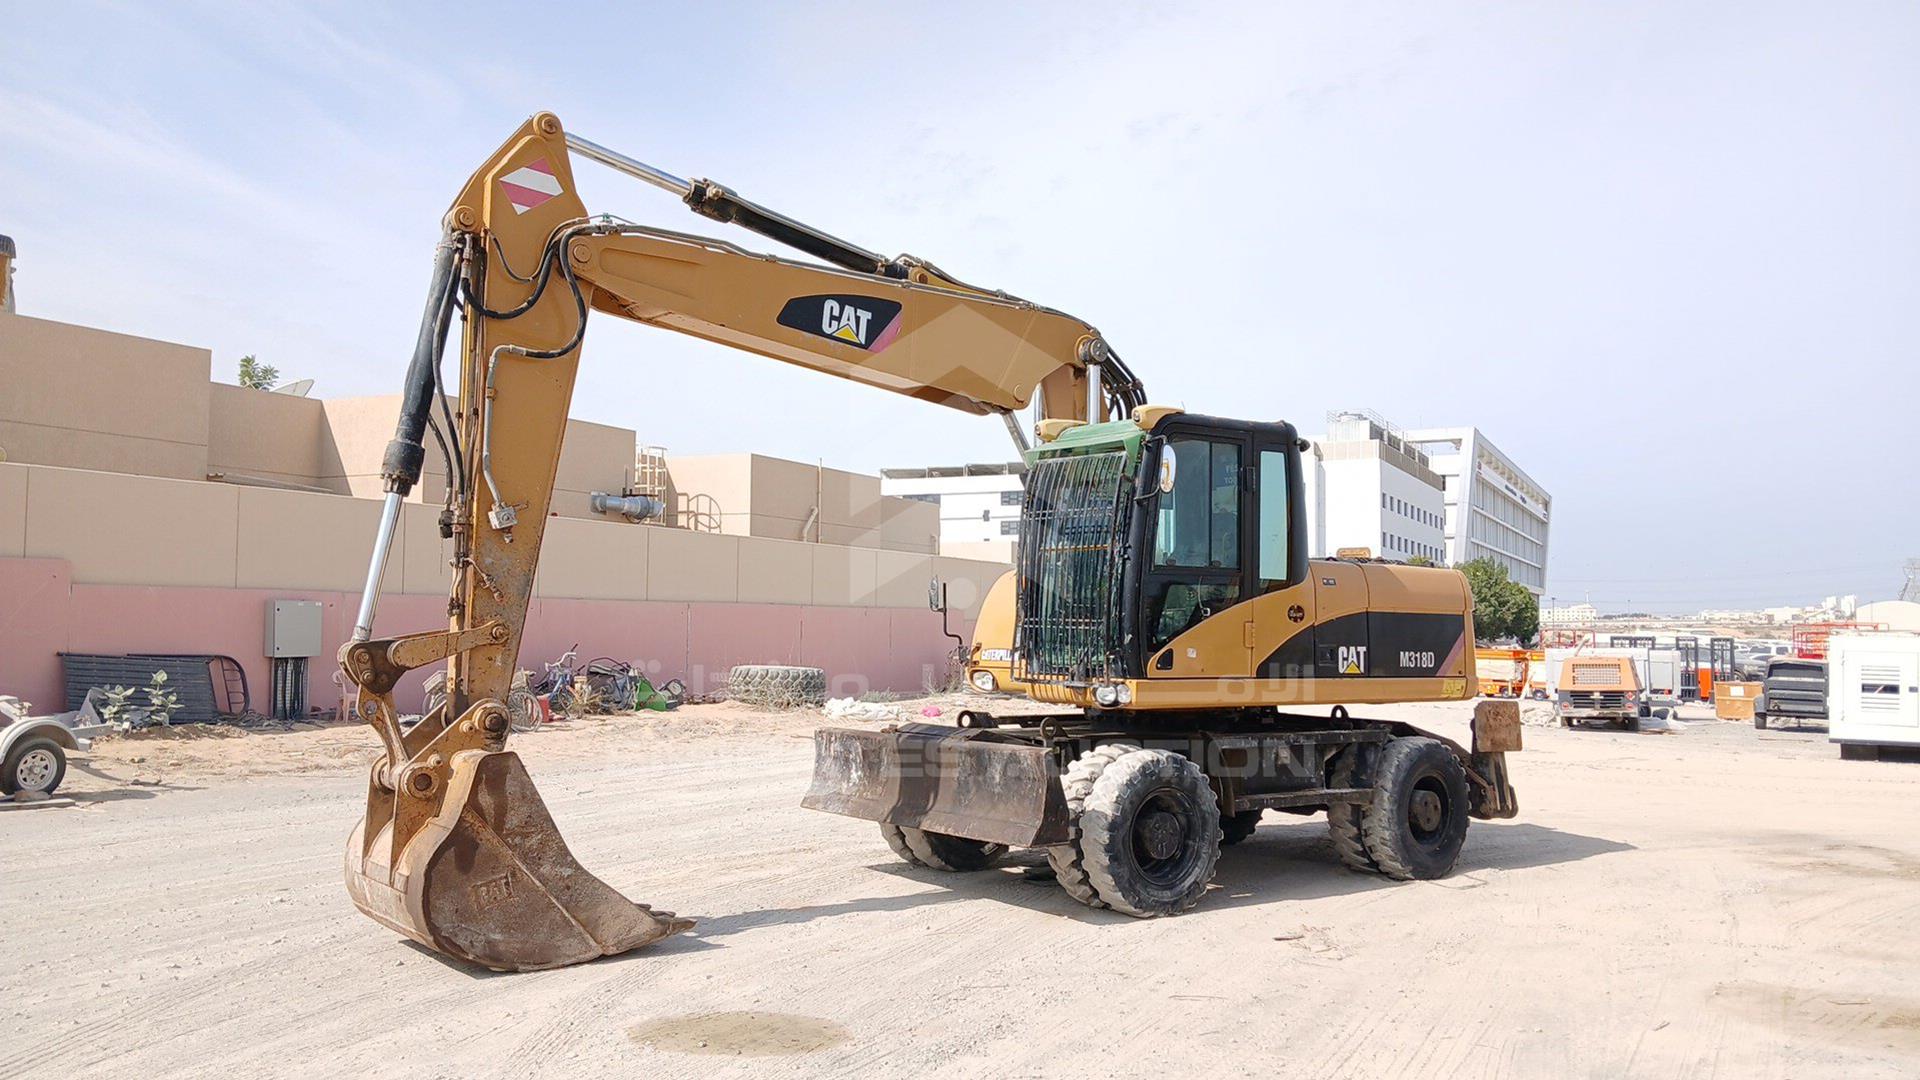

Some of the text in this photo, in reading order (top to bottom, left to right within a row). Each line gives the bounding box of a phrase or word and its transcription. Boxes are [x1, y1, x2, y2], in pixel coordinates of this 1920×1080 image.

[822, 299, 872, 344] CAT
[981, 648, 1020, 661] CATERPILL
[1338, 646, 1367, 674] CAT
[1400, 651, 1435, 668] M318D
